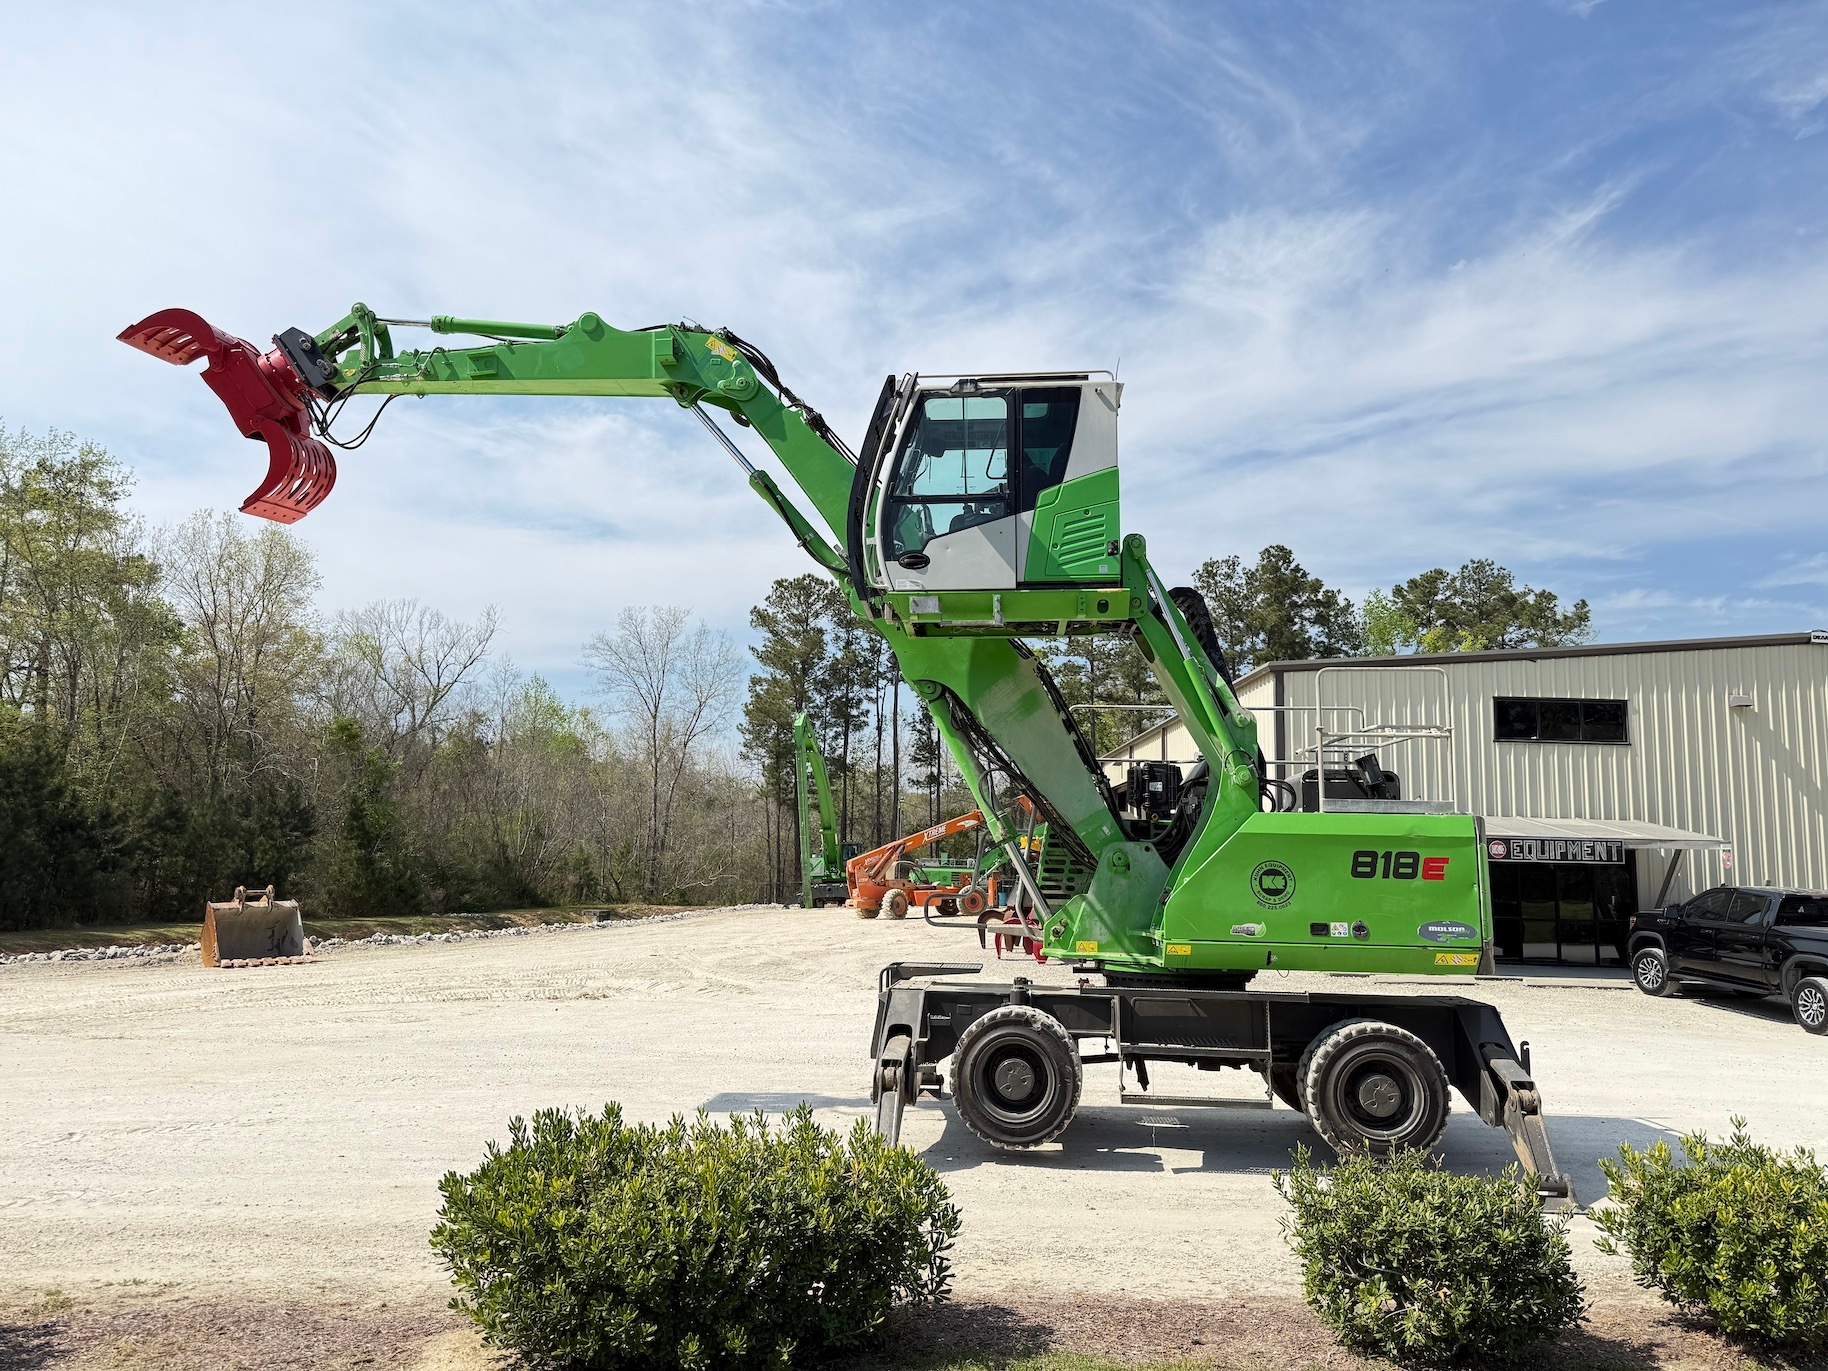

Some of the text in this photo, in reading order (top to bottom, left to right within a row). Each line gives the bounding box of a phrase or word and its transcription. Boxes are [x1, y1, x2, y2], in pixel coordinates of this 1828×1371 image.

[922, 825, 946, 844] XTREME
[1510, 840, 1621, 860] EQUIPMENT
[1264, 863, 1293, 881] EQUIPMENT
[1351, 850, 1450, 880] 818E
